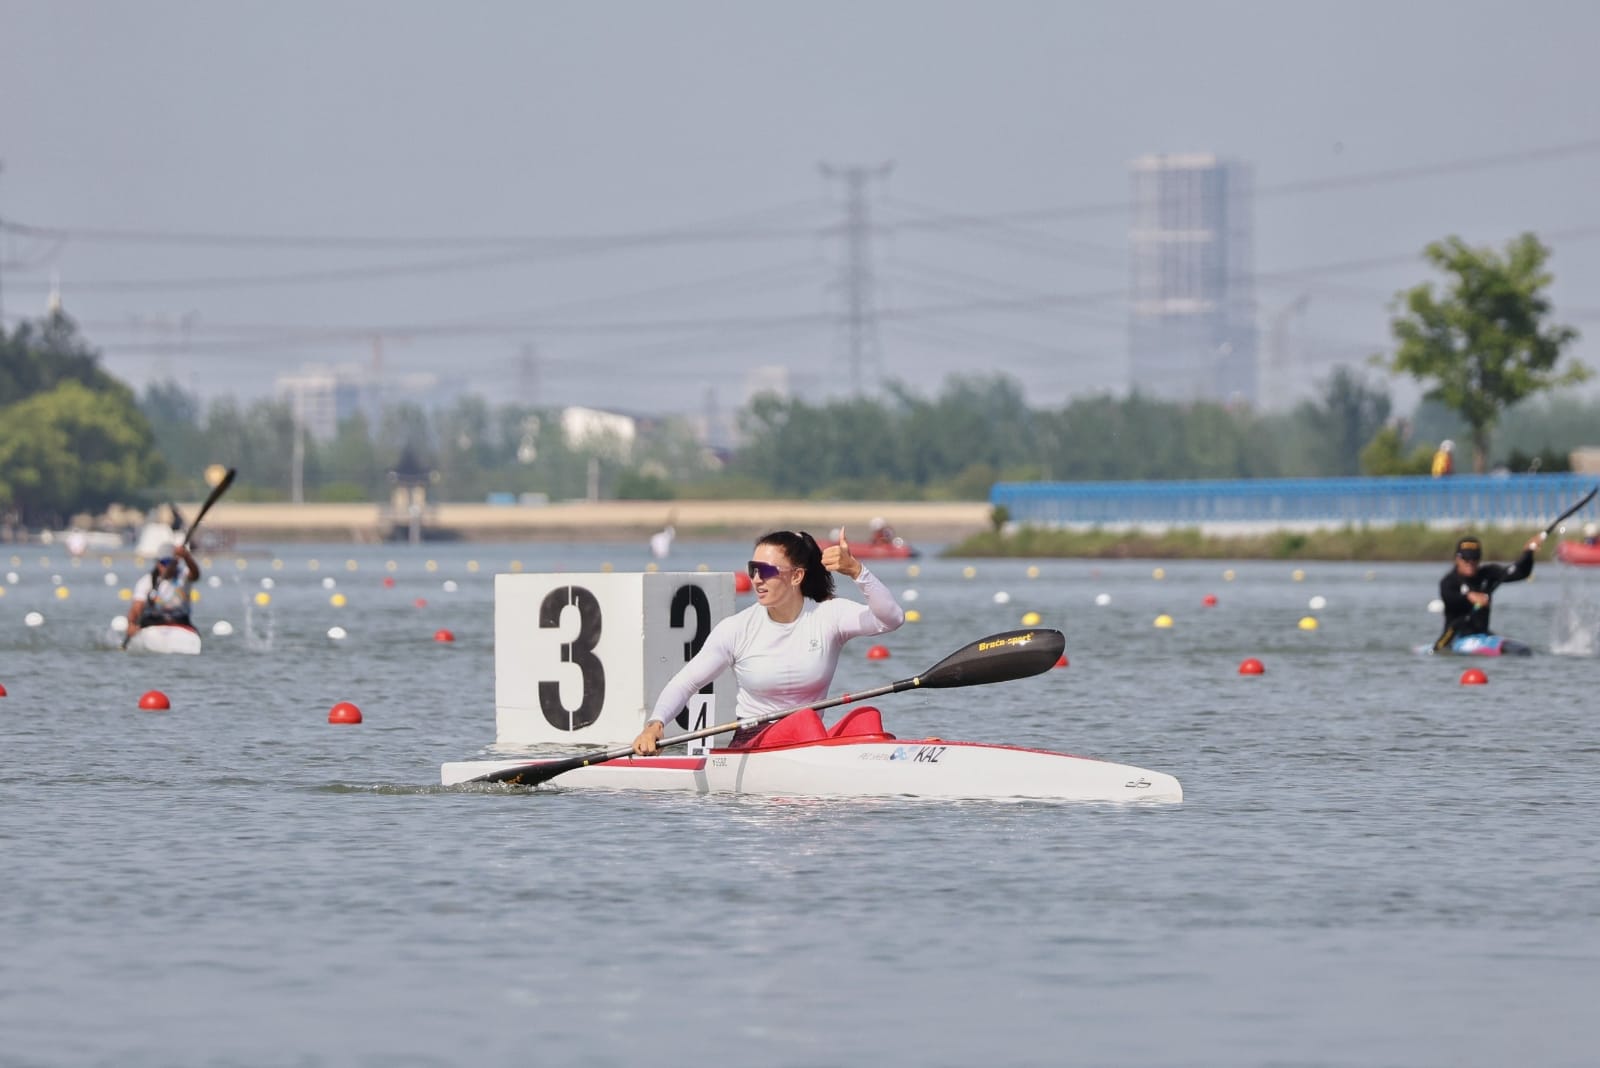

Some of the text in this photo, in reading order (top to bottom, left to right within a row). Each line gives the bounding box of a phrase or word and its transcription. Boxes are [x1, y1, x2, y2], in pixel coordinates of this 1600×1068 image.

[538, 585, 606, 732] 3
[693, 702, 707, 747] 4
[913, 746, 946, 763] KAZ
